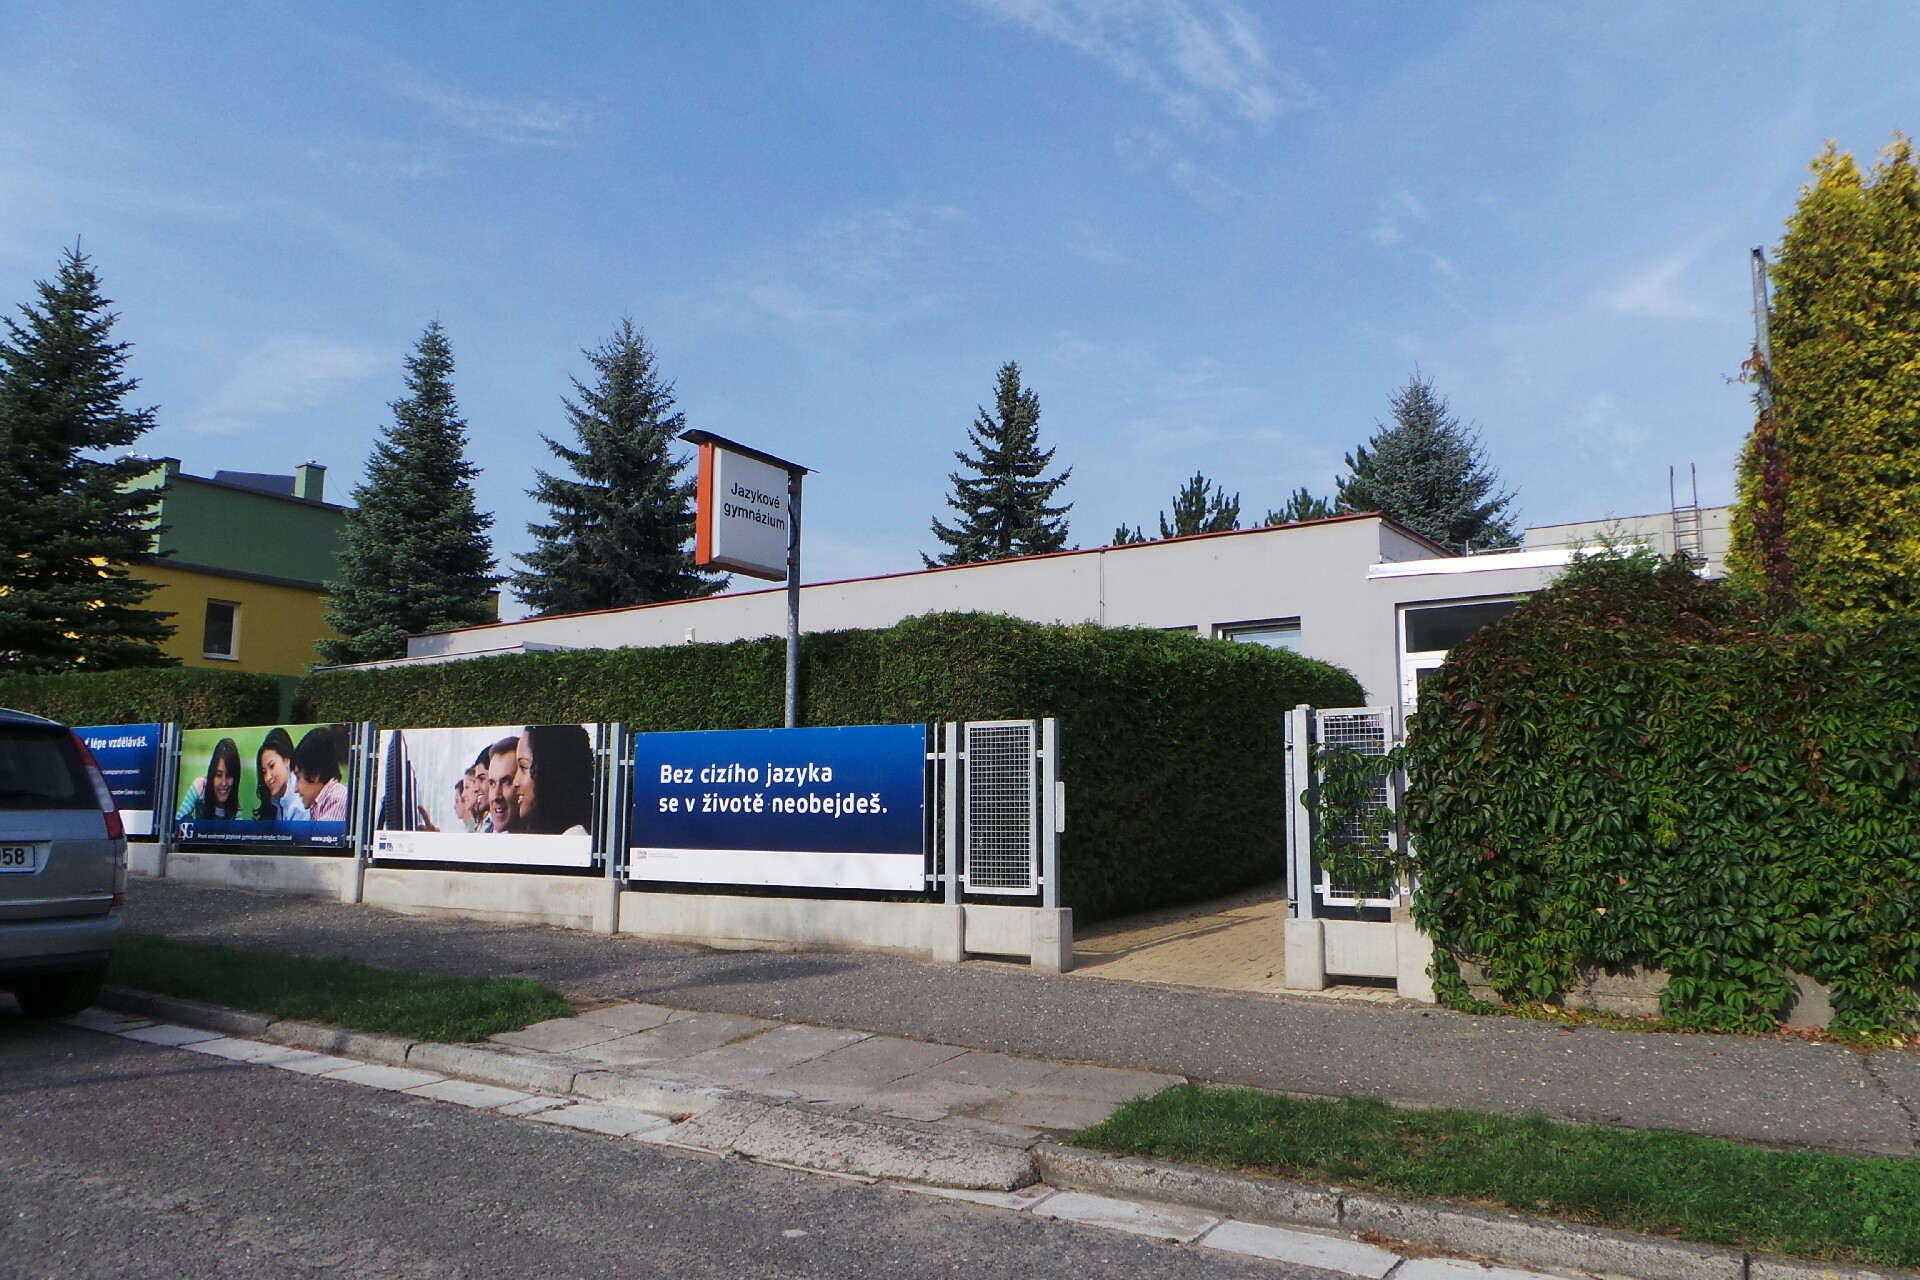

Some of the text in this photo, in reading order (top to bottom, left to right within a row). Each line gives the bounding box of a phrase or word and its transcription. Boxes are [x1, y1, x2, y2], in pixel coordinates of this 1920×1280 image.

[731, 482, 780, 509] Jazykové
[724, 501, 785, 530] gymnázium
[90, 737, 107, 750] lépe
[108, 735, 148, 749] vzděláváš.
[660, 762, 833, 787] Bez cizího jazyka
[659, 792, 888, 819] se v životě neobejdeš.
[0, 847, 25, 865] 58
